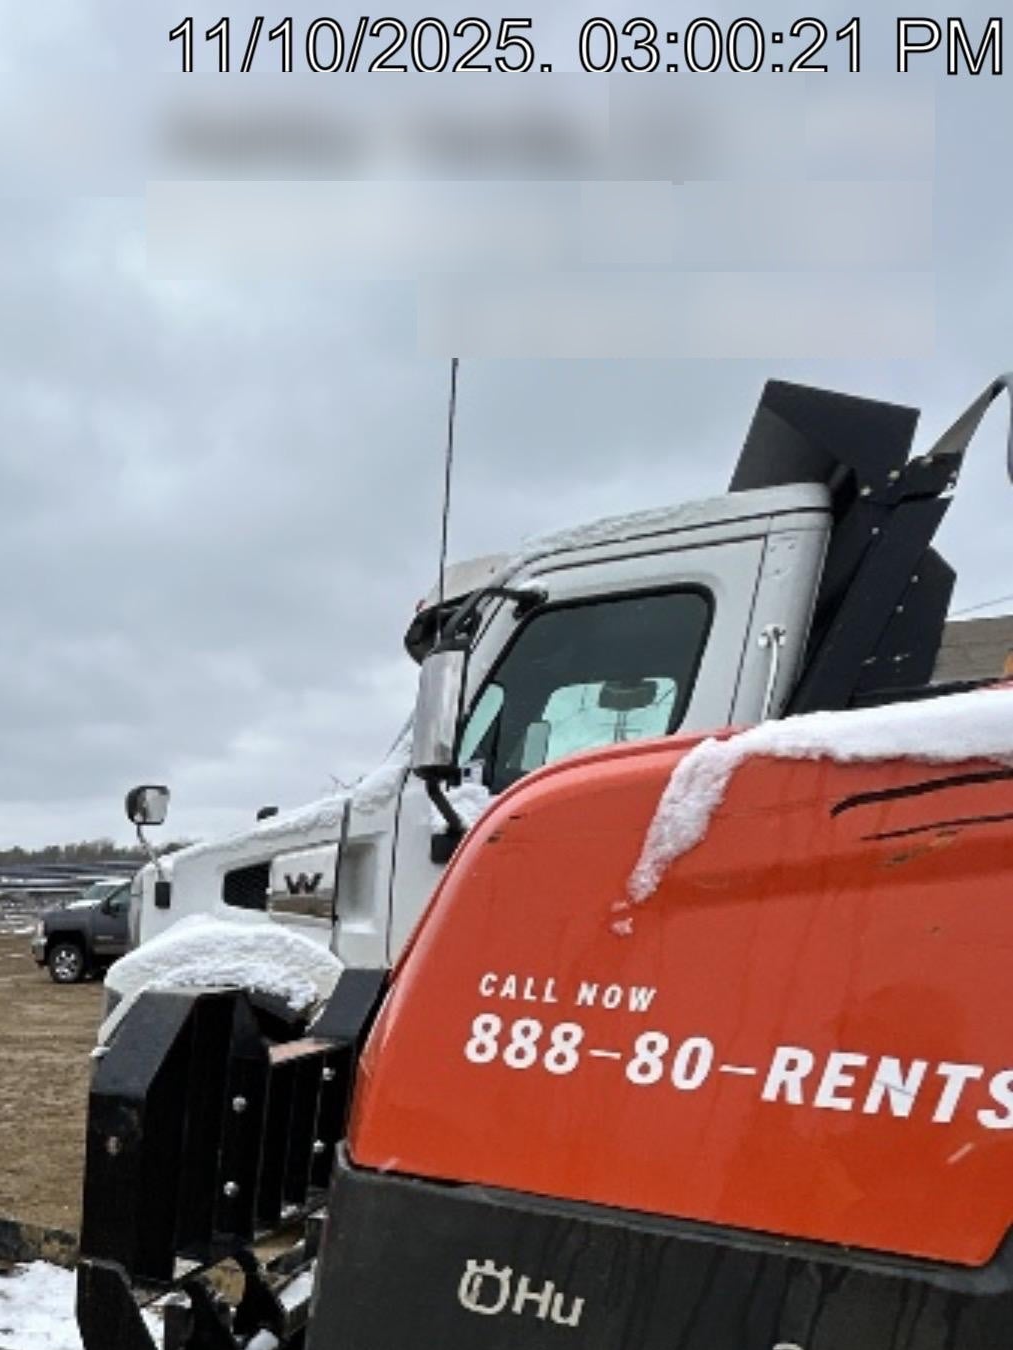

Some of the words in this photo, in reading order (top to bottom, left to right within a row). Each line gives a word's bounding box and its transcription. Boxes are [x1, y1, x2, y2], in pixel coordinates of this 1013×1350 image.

[479, 973, 559, 1004] CALL
[577, 983, 657, 1012] NOW
[463, 1012, 1013, 1129] 888-80-RENTS
